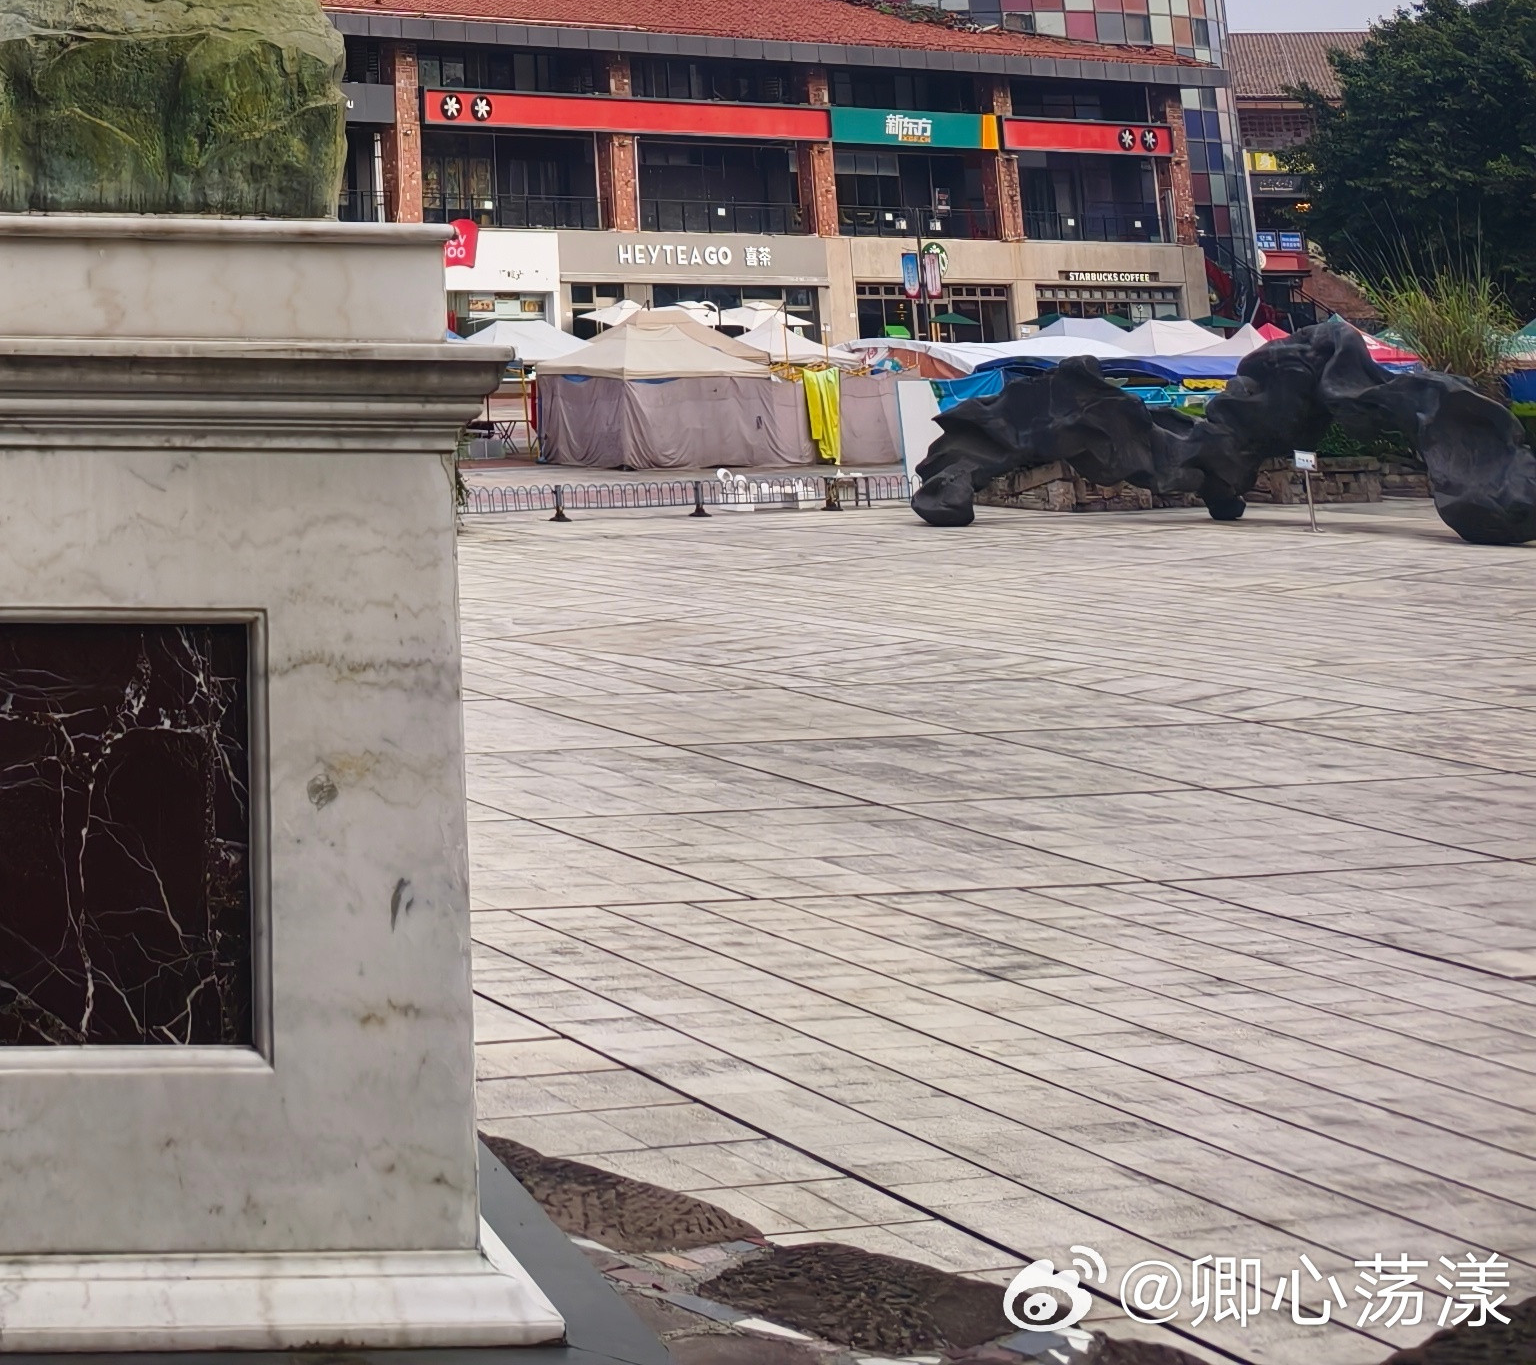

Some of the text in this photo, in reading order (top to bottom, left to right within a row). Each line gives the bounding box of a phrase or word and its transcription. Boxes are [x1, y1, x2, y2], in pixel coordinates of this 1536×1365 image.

[885, 113, 933, 141] 新东方
[618, 244, 772, 266] HEYTEAGO 喜茶
[1069, 272, 1151, 283] STARBUCKS COFFEE
